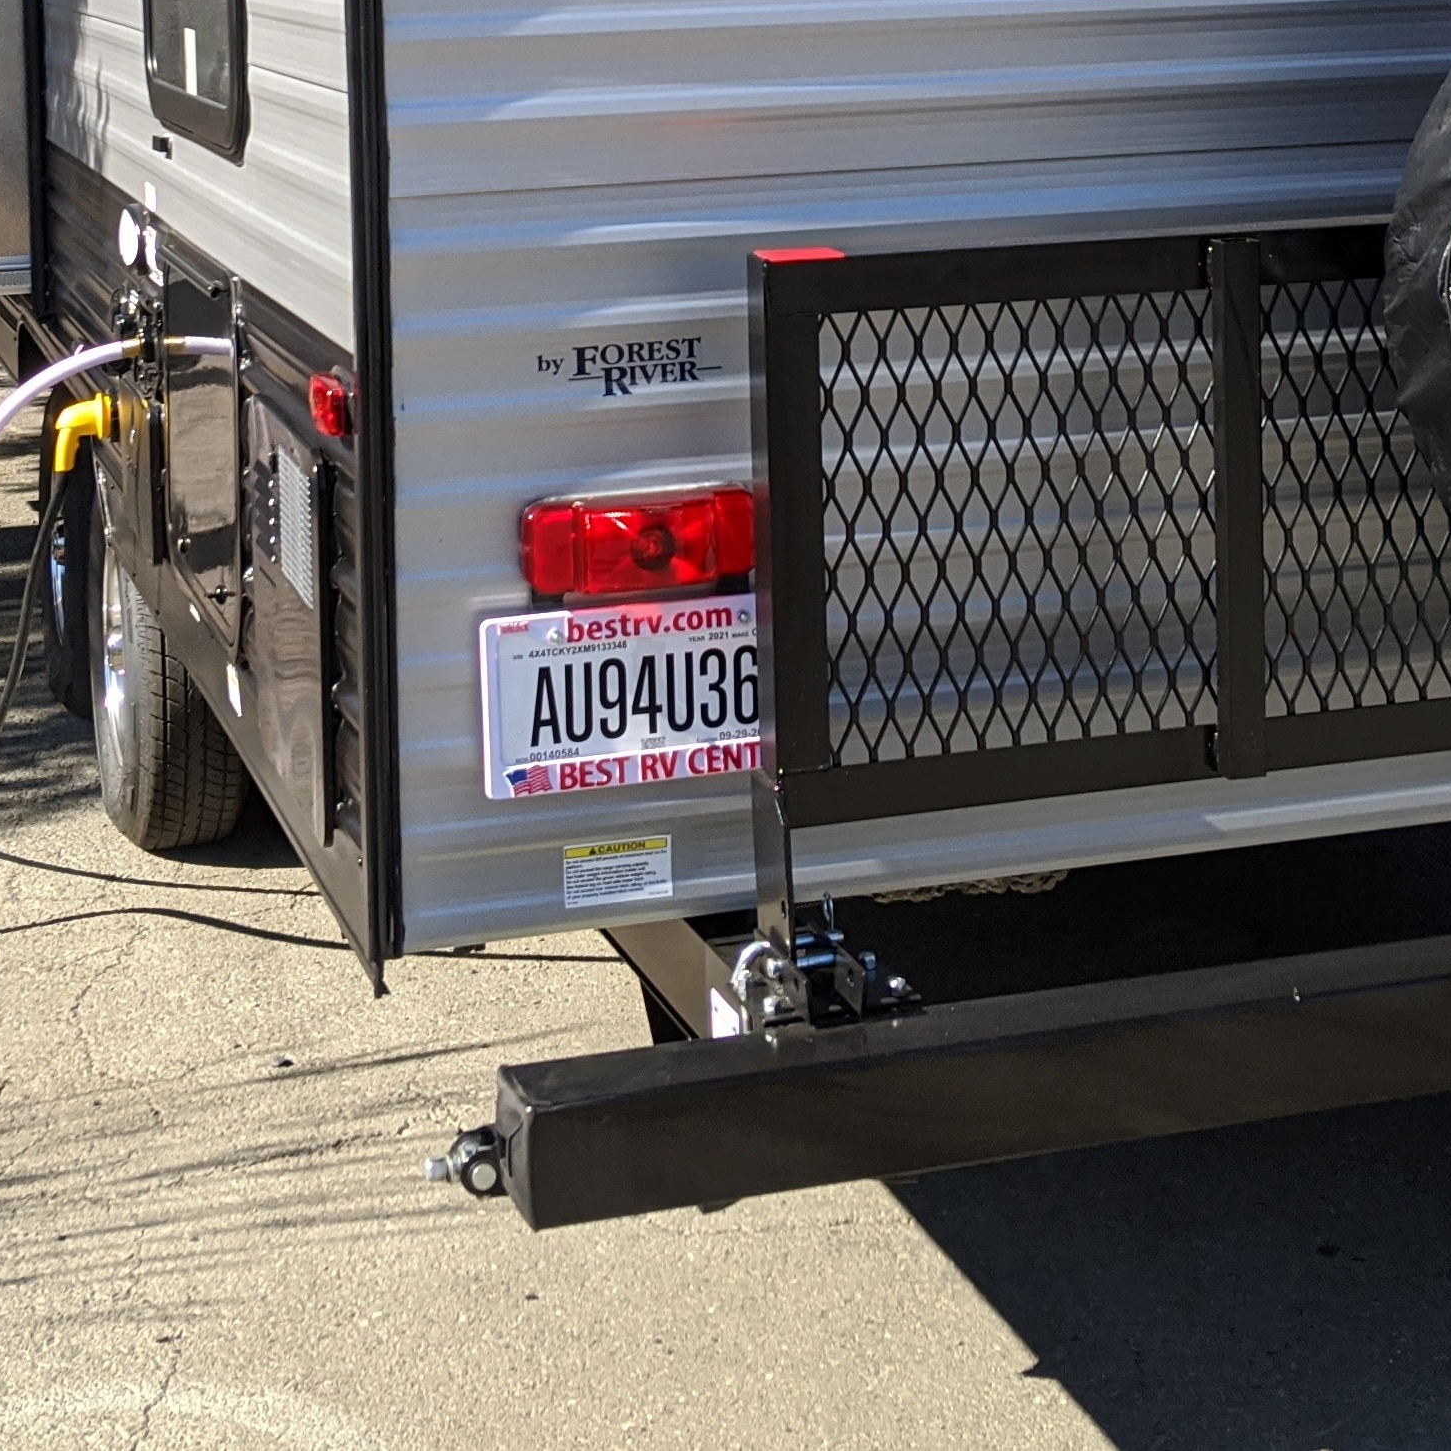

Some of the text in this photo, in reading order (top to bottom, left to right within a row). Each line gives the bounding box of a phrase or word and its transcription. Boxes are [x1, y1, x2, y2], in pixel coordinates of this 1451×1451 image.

[536, 336, 702, 377] by FOREST
[601, 360, 699, 397] RIVER
[566, 606, 733, 643] bestrv.com
[708, 631, 729, 641] 2021
[530, 644, 759, 747] AU94U36
[719, 728, 759, 741] 09-29-2
[529, 747, 579, 762] 00140584
[559, 741, 761, 790] BEST RV CENT
[597, 841, 647, 854] CAUTION
